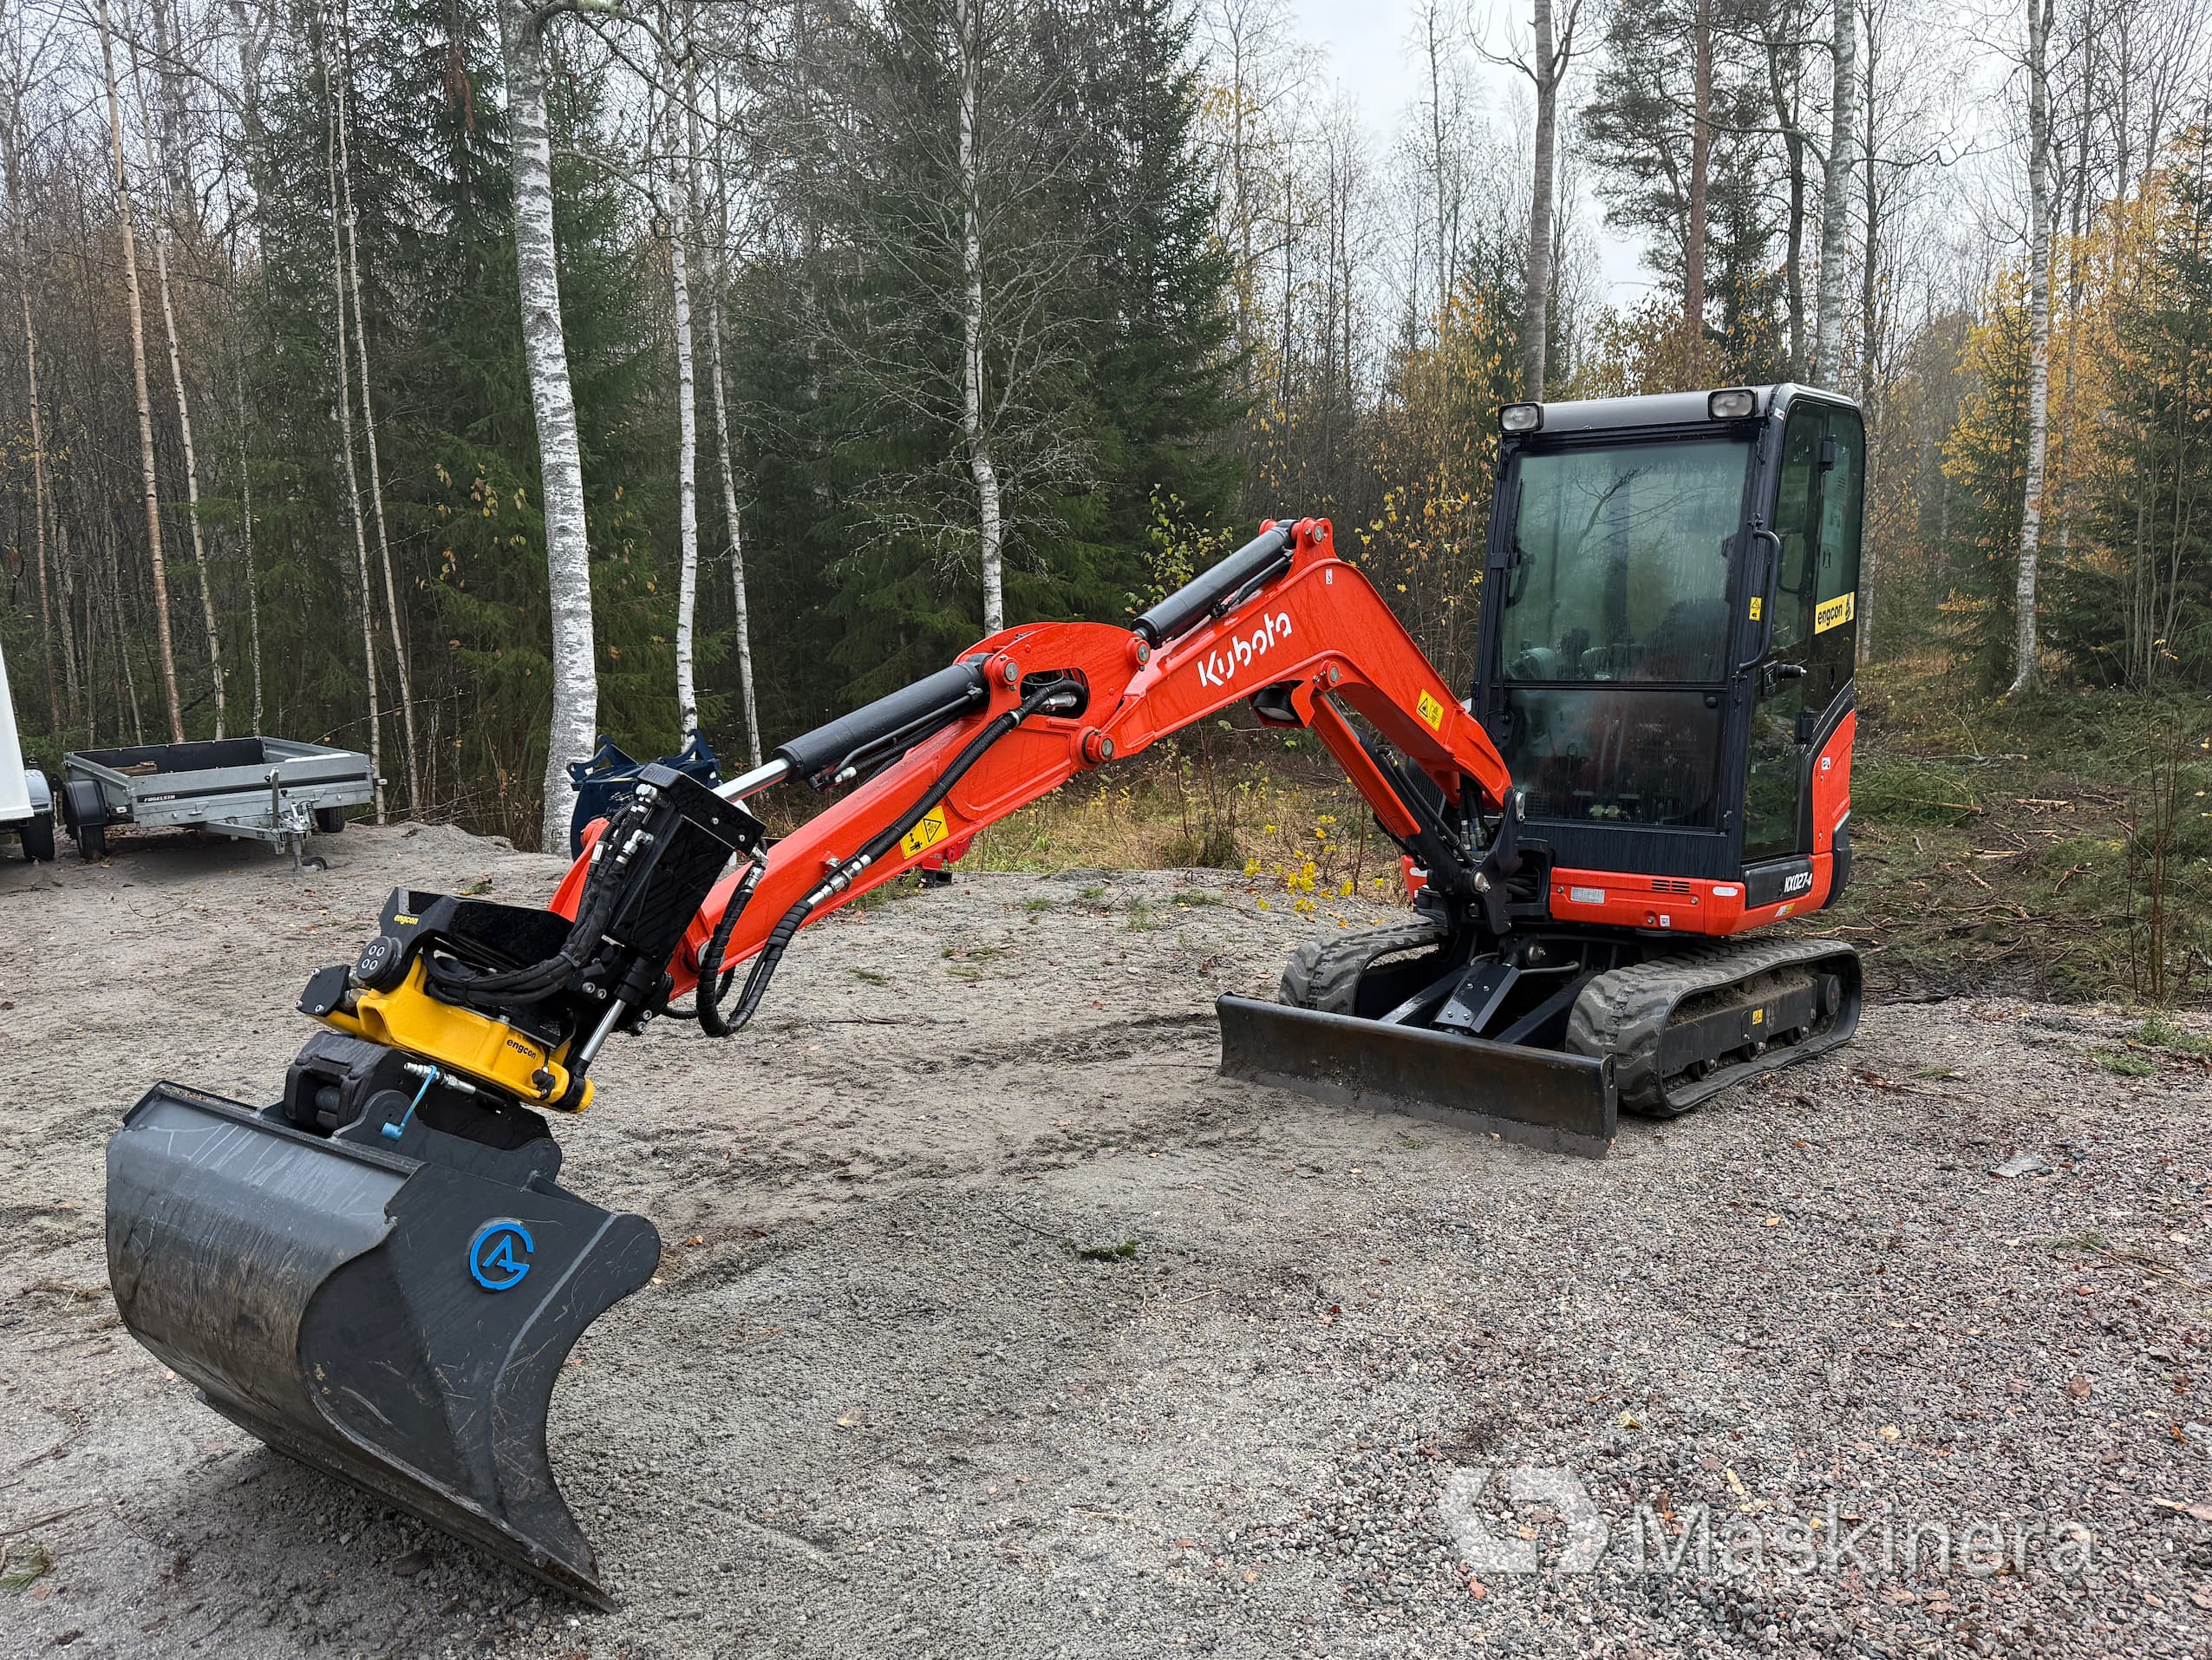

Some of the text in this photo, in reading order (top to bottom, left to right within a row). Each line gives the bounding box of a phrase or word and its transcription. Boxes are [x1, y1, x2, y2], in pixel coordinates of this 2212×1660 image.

[1817, 604, 1843, 626] engcon
[1197, 612, 1292, 687] Kubota
[1784, 872, 1813, 892] KX027-4
[394, 915, 419, 925] engcon
[506, 1039, 537, 1059] engcon
